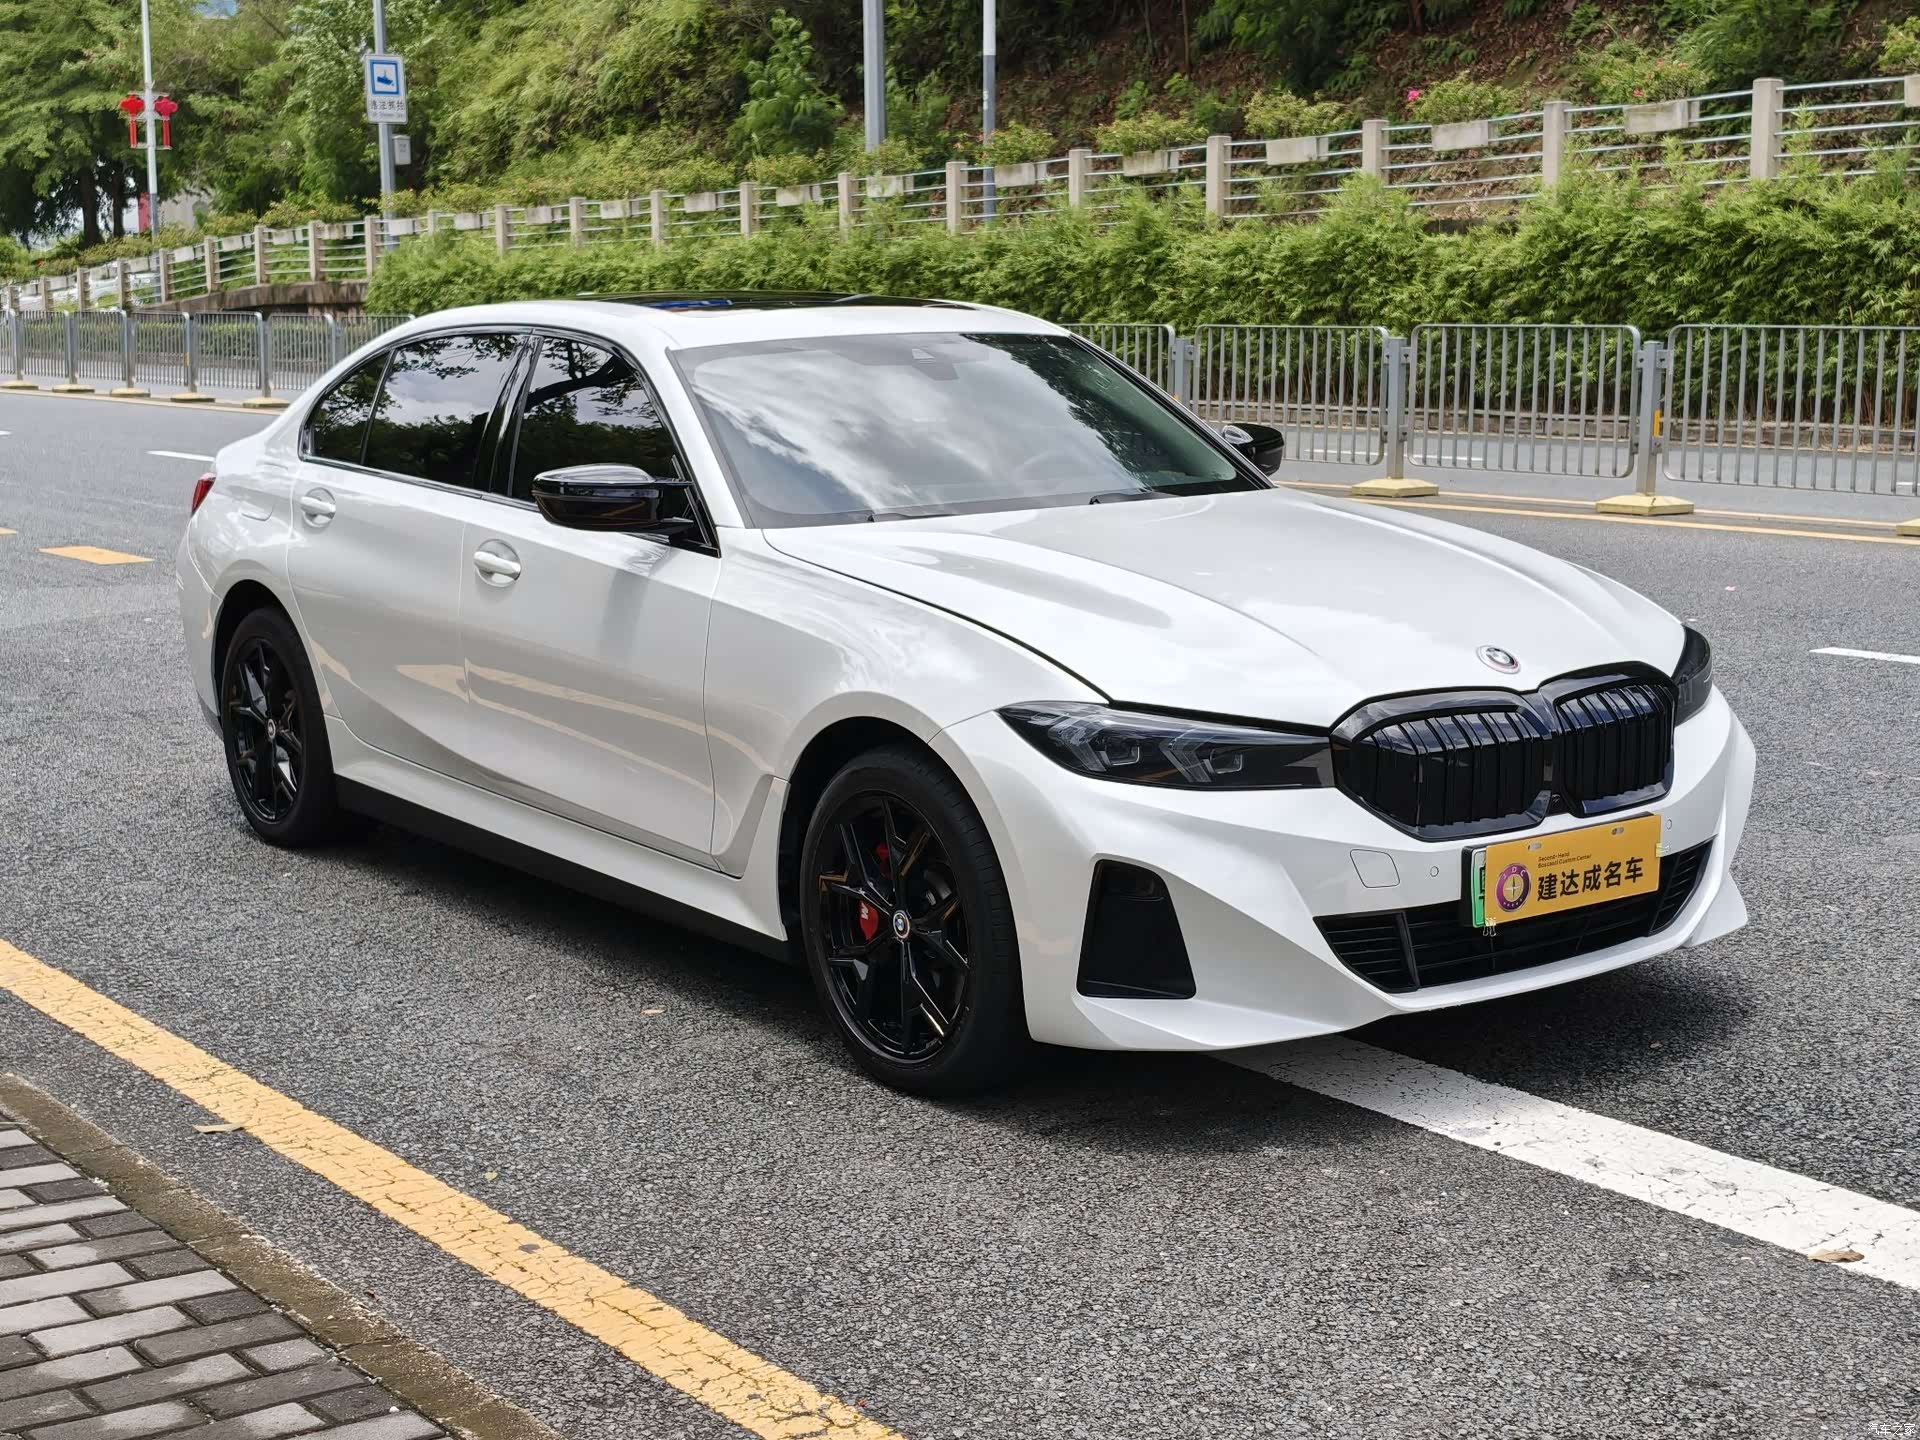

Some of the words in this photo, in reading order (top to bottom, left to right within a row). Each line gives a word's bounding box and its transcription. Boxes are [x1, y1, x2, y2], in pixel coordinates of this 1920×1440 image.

[1537, 857, 1643, 901] 建达成名车
